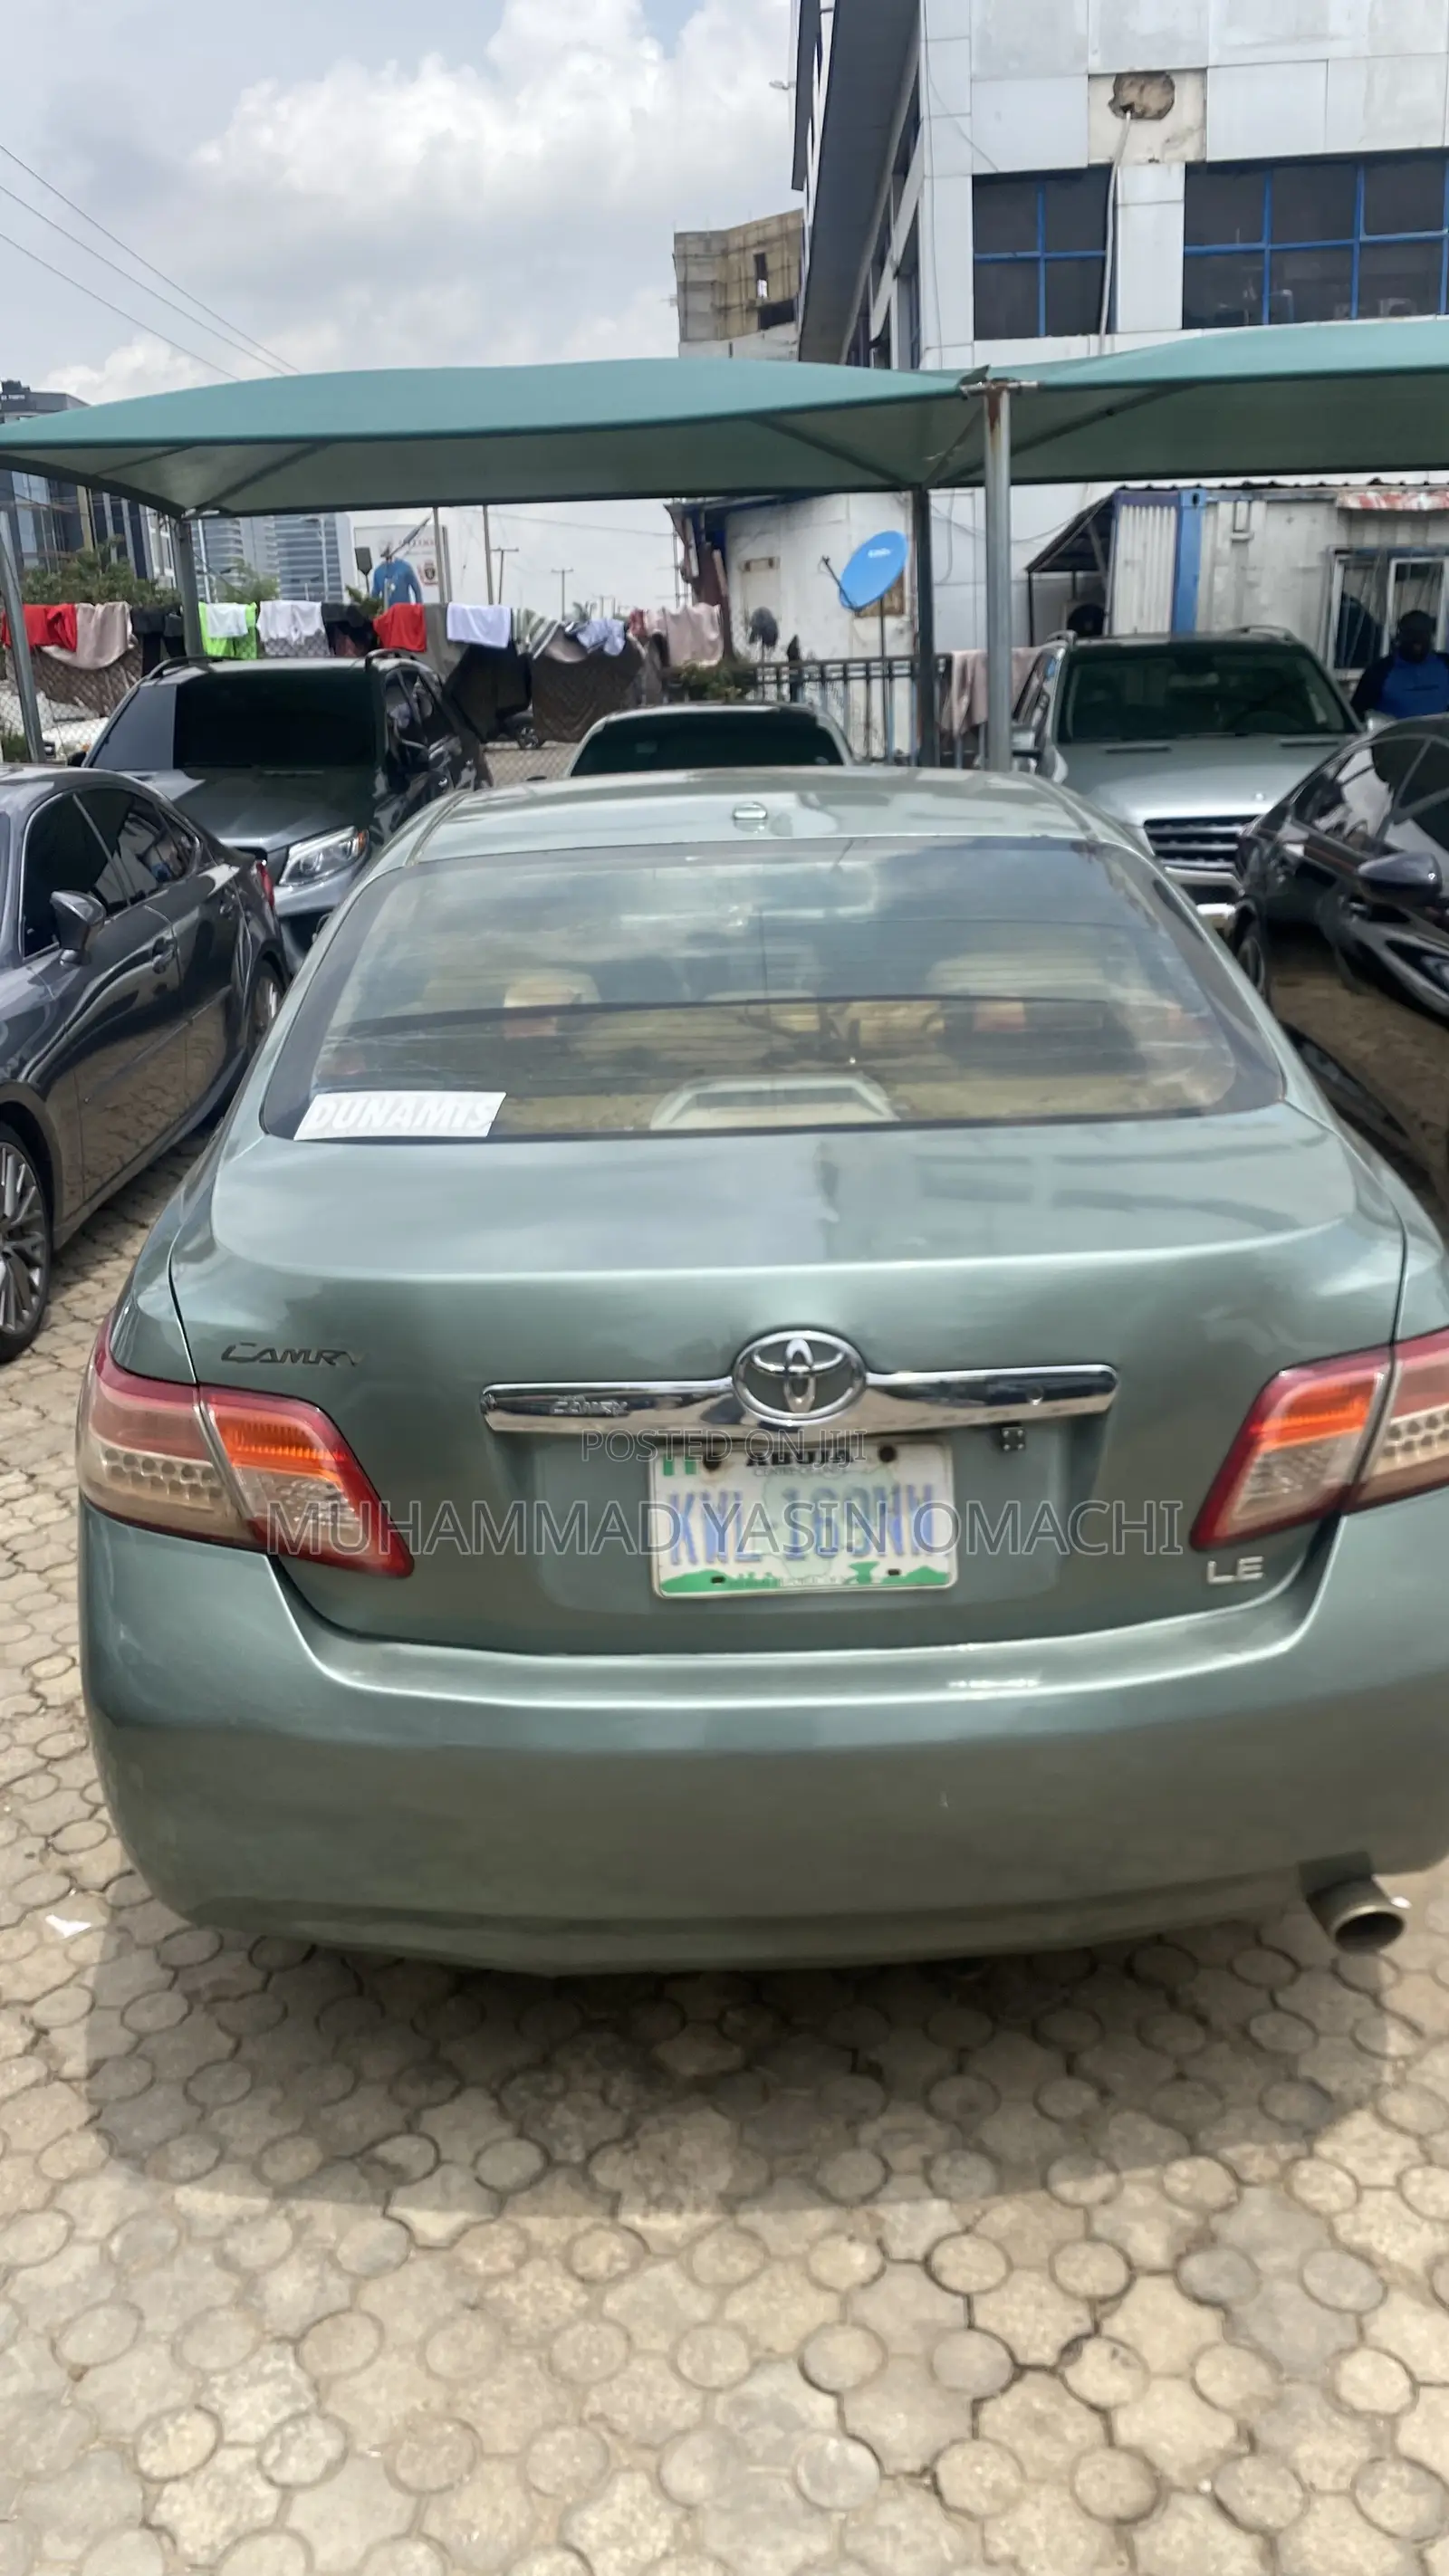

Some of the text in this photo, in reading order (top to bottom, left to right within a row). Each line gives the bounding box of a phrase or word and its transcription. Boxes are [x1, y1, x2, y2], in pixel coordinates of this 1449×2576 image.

[304, 1094, 497, 1132] DUNAMIS
[221, 1341, 366, 1367] CAMRY
[1206, 1556, 1264, 1585] LE
